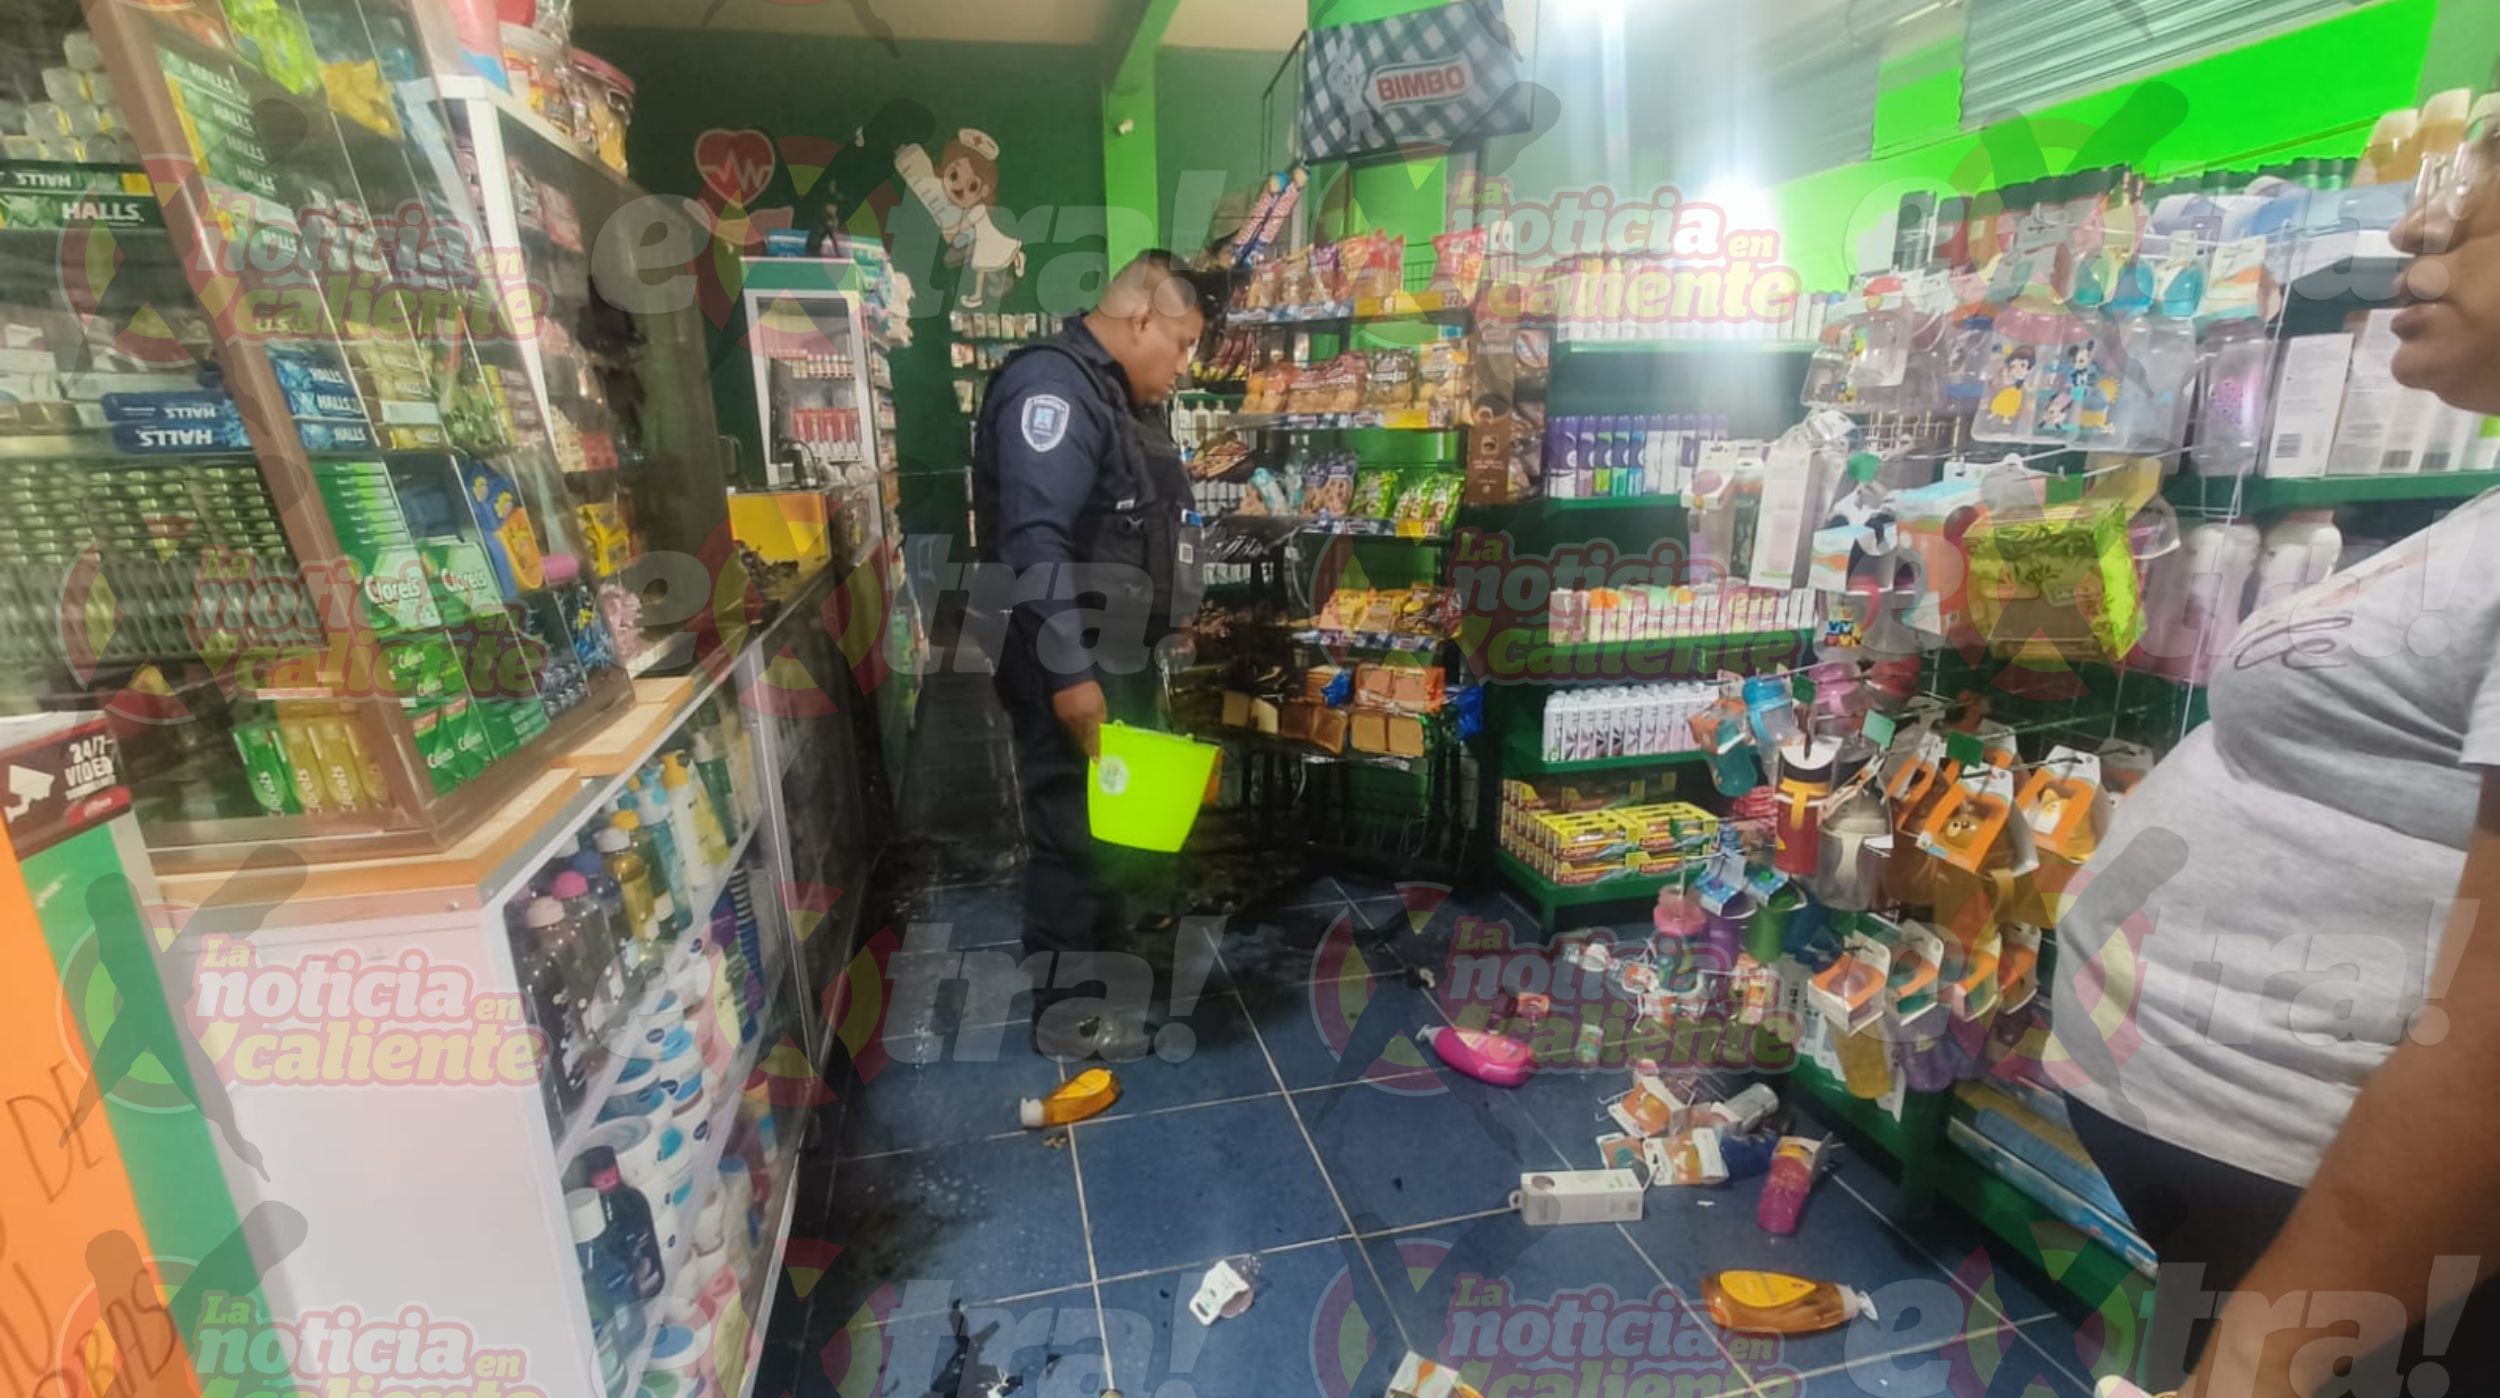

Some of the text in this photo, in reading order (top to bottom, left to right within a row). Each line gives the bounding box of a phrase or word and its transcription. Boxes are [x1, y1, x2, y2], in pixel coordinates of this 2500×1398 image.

[1376, 65, 1465, 101] BIMBO
[62, 202, 142, 221] HALLS
[138, 430, 213, 447] HALLS
[364, 574, 421, 603] Clorets
